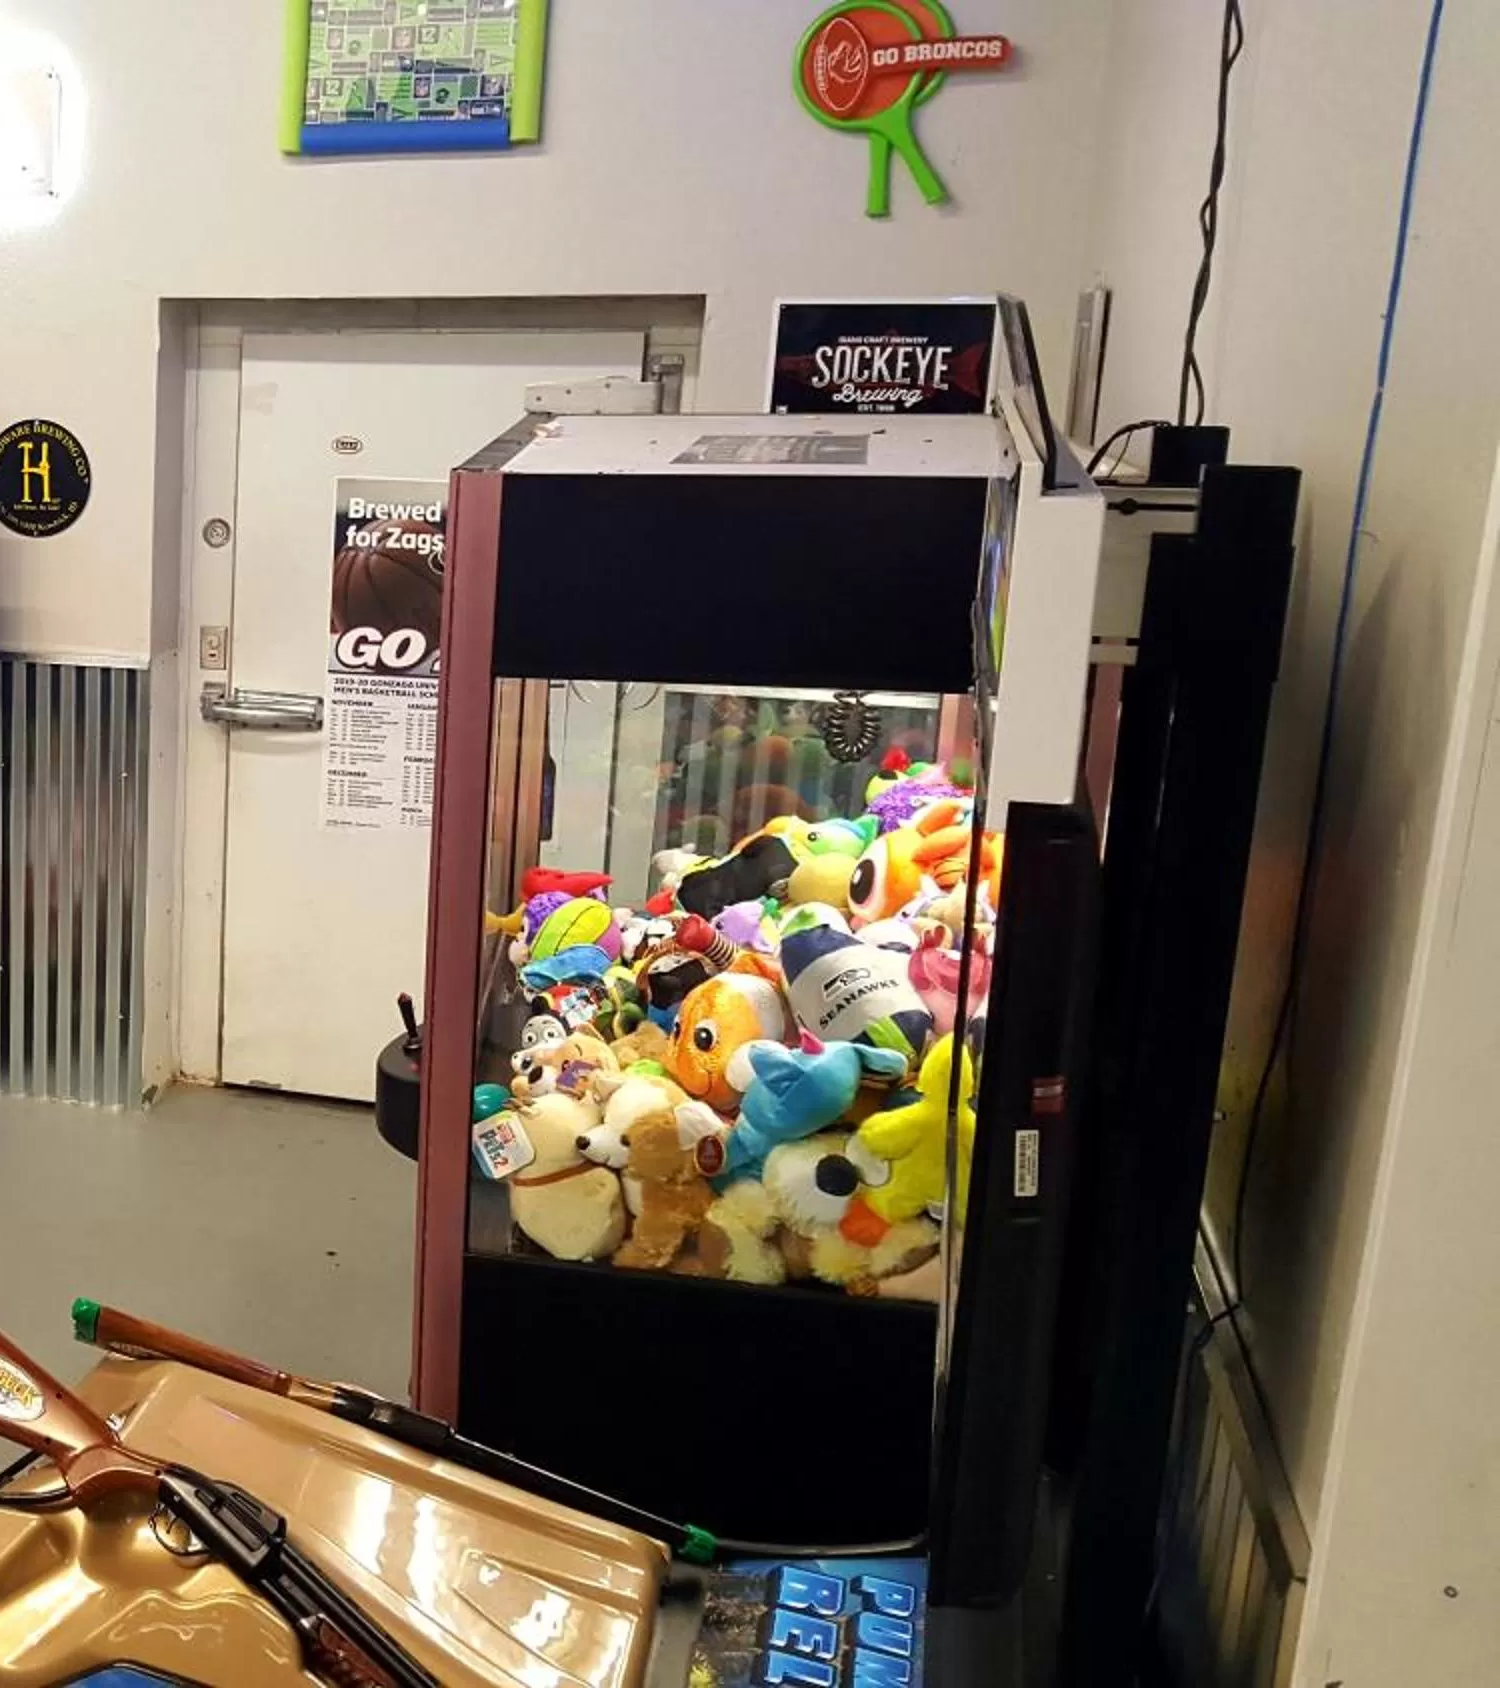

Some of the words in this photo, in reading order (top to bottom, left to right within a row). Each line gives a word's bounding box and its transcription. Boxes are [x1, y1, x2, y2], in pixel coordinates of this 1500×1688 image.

[872, 47, 899, 67] GO
[904, 40, 1002, 63] BRONCOS
[812, 345, 952, 390] SOCKEYE
[832, 383, 924, 409] Brewing
[17, 441, 51, 503] H
[348, 497, 441, 522] Brewed
[346, 526, 381, 548] for
[386, 527, 444, 555] Zags
[336, 626, 426, 670] GO
[333, 686, 360, 695] MEN'S
[362, 687, 416, 697] BASKETBALL
[369, 679, 414, 689] GONZAGA
[820, 979, 899, 1030] SEAHAWKS
